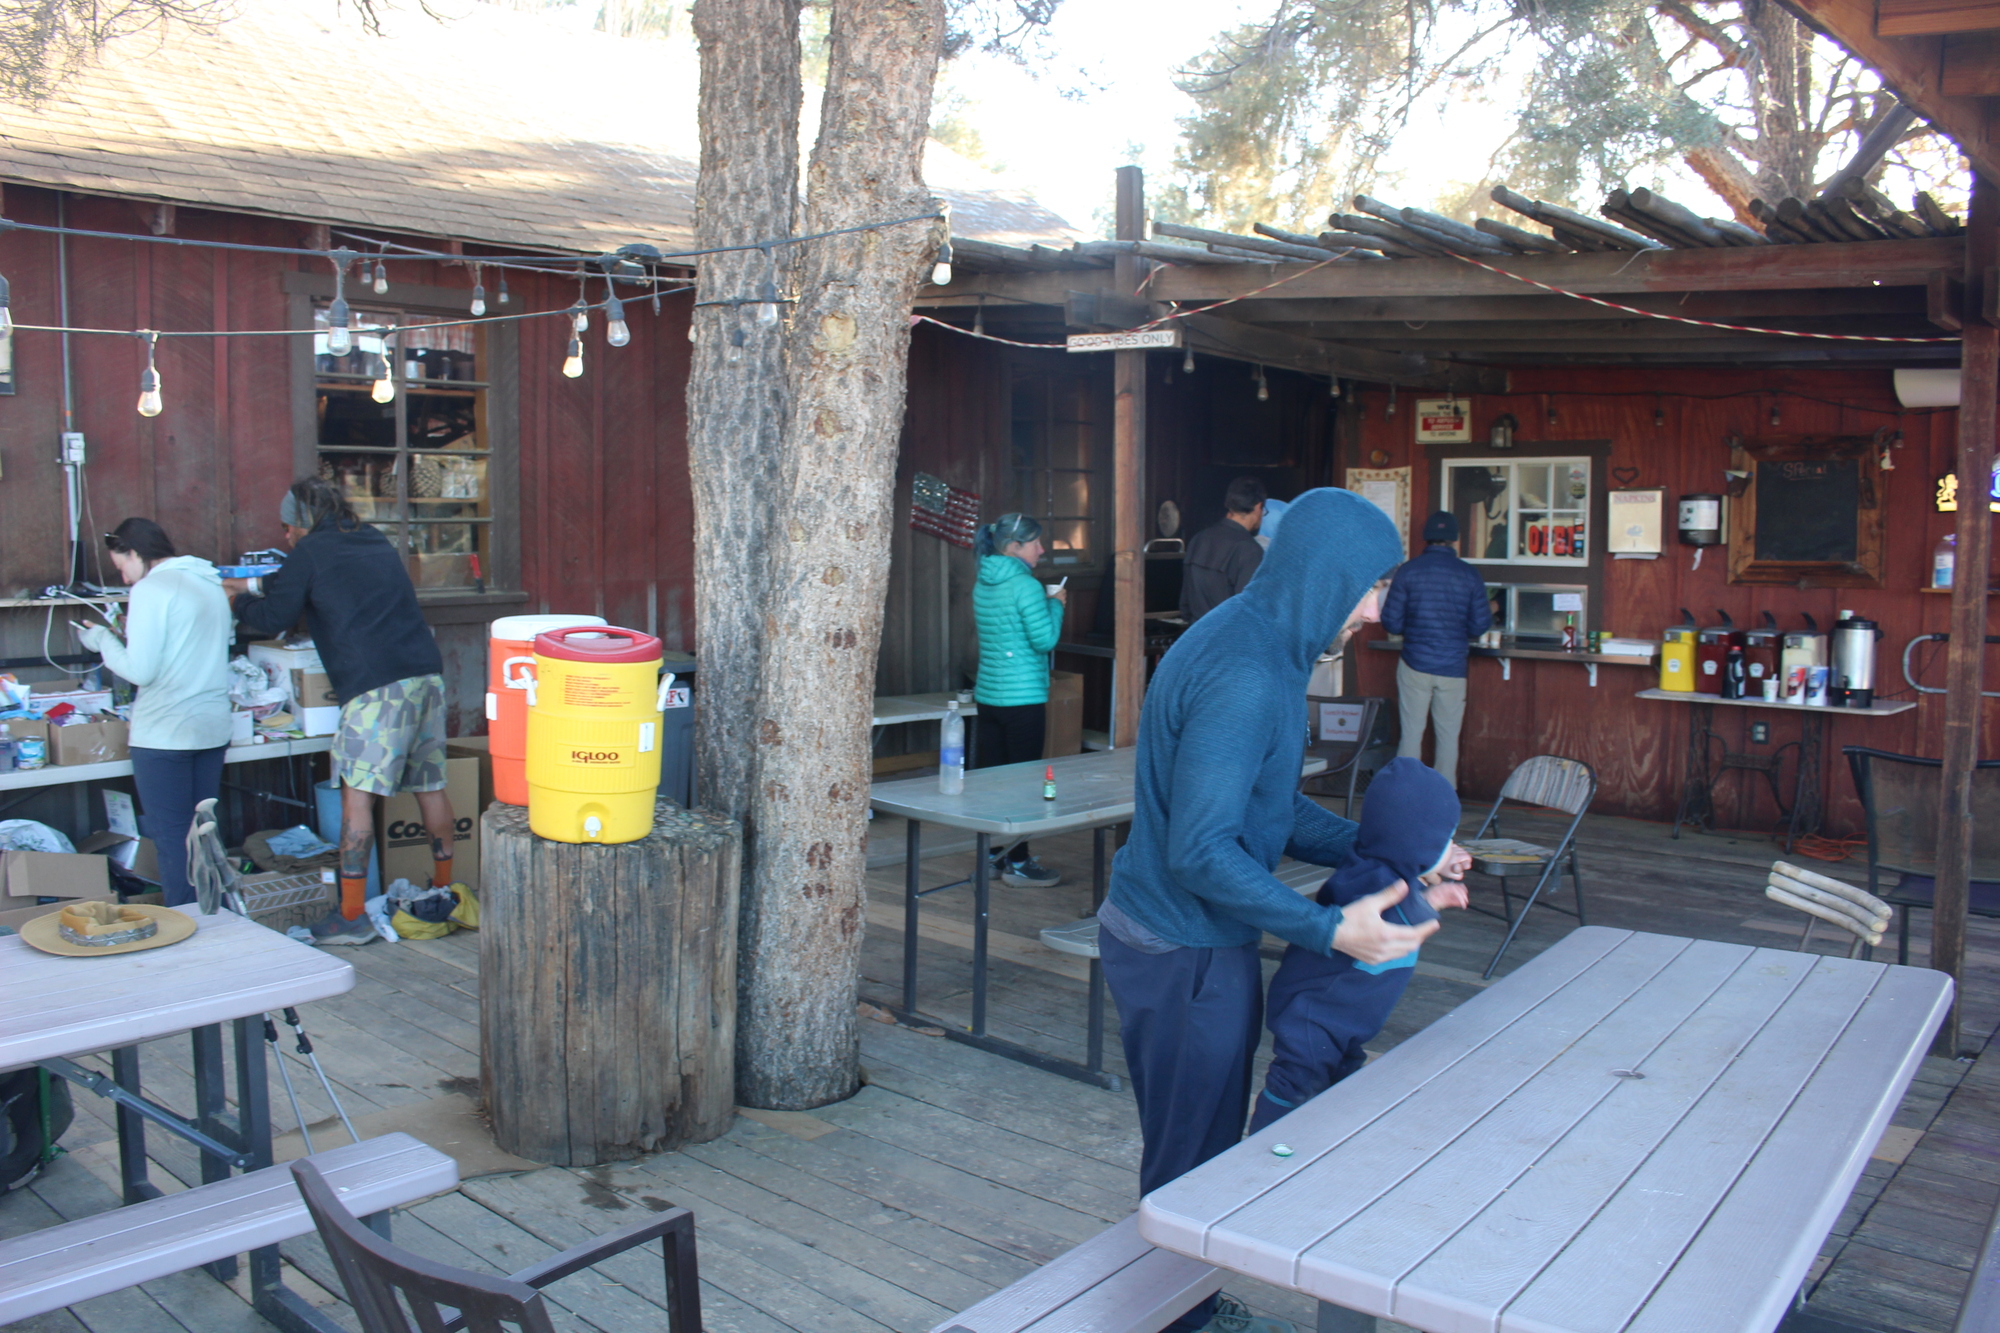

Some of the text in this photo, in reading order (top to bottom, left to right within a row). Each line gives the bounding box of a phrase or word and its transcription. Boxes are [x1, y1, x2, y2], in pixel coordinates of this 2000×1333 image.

[1069, 333, 1173, 347] GOOD VIBES ONLY
[1613, 494, 1656, 503] NAPKINS
[572, 751, 619, 763] IGLOO
